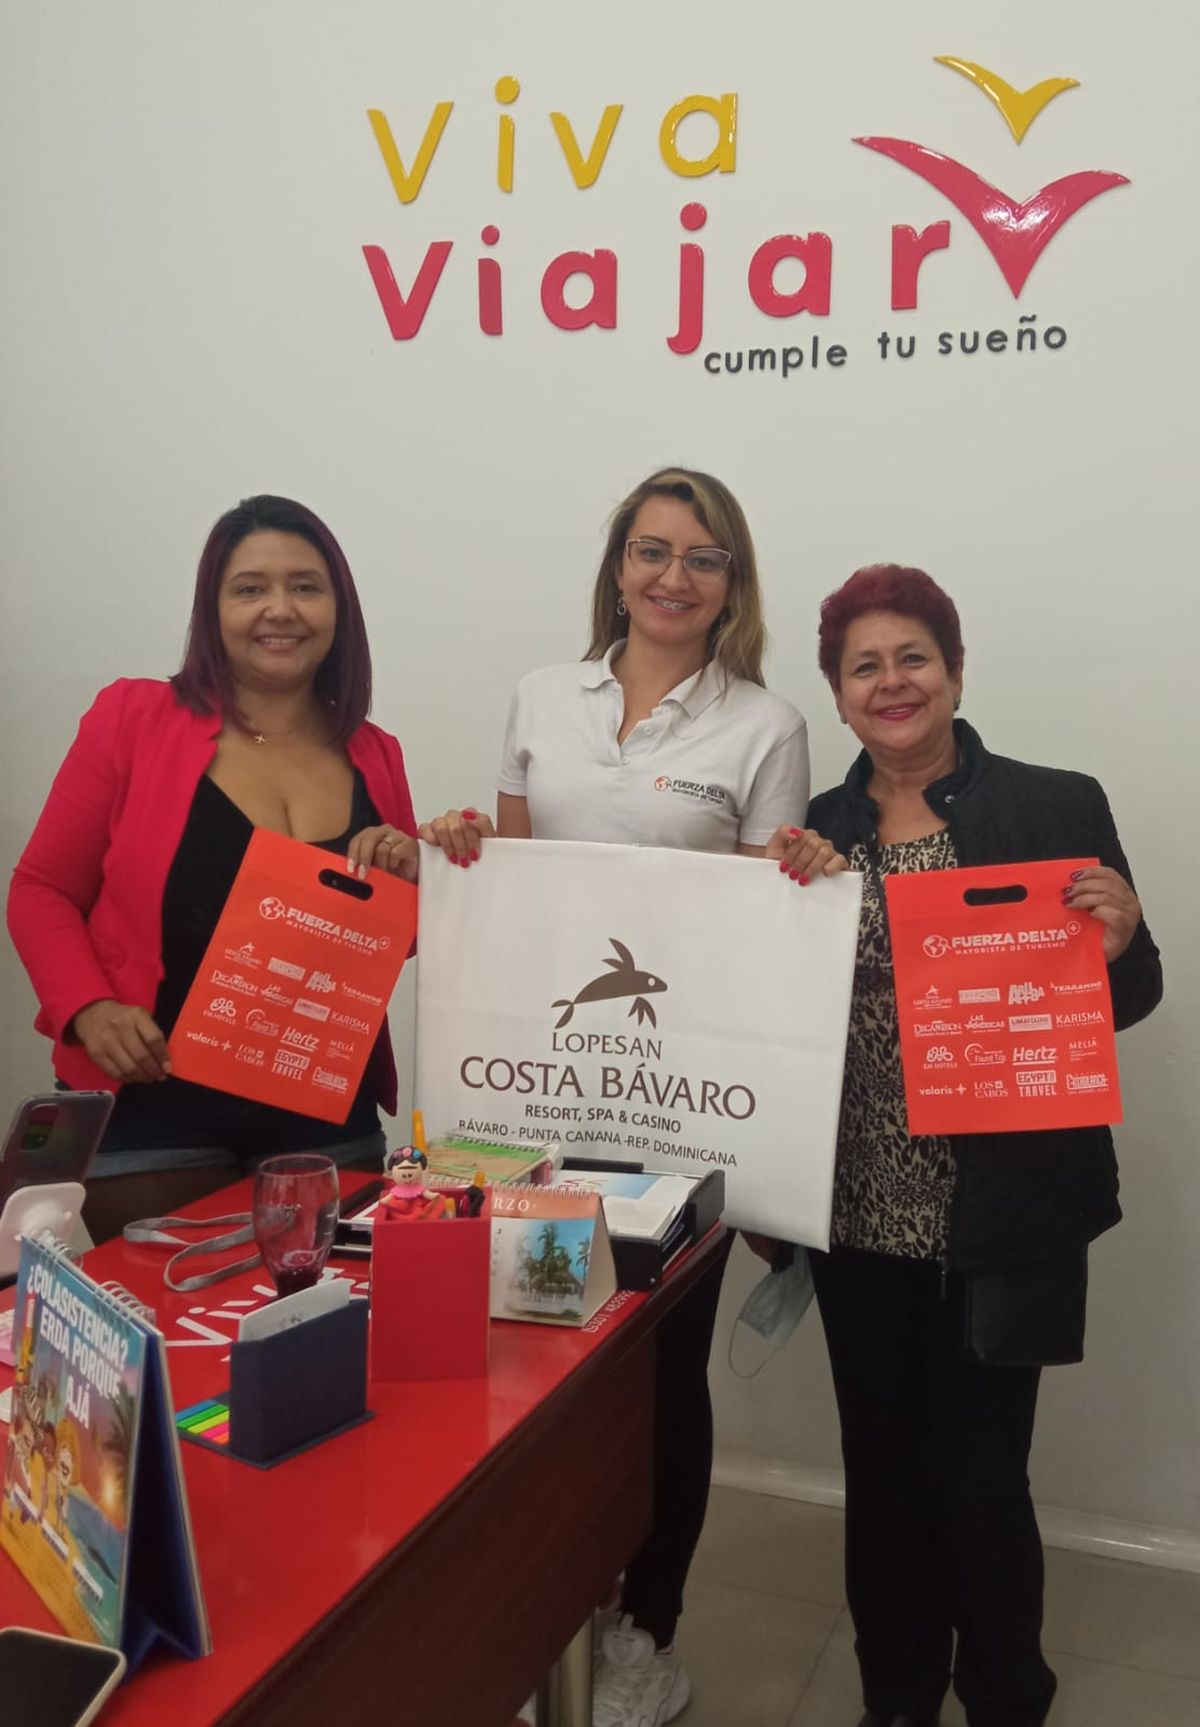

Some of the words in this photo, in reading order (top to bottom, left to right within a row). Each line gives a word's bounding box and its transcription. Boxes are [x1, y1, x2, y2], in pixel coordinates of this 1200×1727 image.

[704, 336, 848, 377] cumple
[878, 330, 916, 360] tu
[937, 315, 1068, 354] sueño
[287, 907, 341, 937] FUERZA
[342, 928, 379, 951] DELTA
[952, 933, 1015, 948] FUERZA
[1017, 928, 1069, 944] DELTA
[955, 945, 1006, 955] MAYORISTA
[1010, 943, 1021, 951] DE
[1026, 941, 1066, 951] TURISMO
[330, 1011, 370, 1035] KARISMA
[1055, 1011, 1105, 1025] KARISMA
[187, 1031, 219, 1047] volaris
[281, 1026, 320, 1051] Hertz
[552, 1032, 662, 1060] LOPESAN
[1012, 1046, 1058, 1062] Hertz
[272, 1062, 303, 1080] TRAVEL
[460, 1056, 584, 1098] COSTA
[601, 1063, 756, 1120] BÁVARO
[919, 1084, 953, 1096] volaris
[1018, 1084, 1057, 1097] TRAVEL
[525, 1104, 582, 1122] RESORT,
[587, 1107, 614, 1122] SPA
[619, 1111, 628, 1123] &
[632, 1113, 681, 1133] CASINO
[459, 1119, 508, 1136] BÁVARO
[519, 1127, 562, 1142] PUNTA
[565, 1130, 621, 1145] CANANA
[653, 1139, 737, 1167] DOMINICANA
[27, 1264, 128, 1372] ¿COLASISTENCIA?
[40, 1305, 70, 1360] ERDA
[72, 1335, 121, 1404] PORQUE
[65, 1375, 90, 1429] AJÁ
